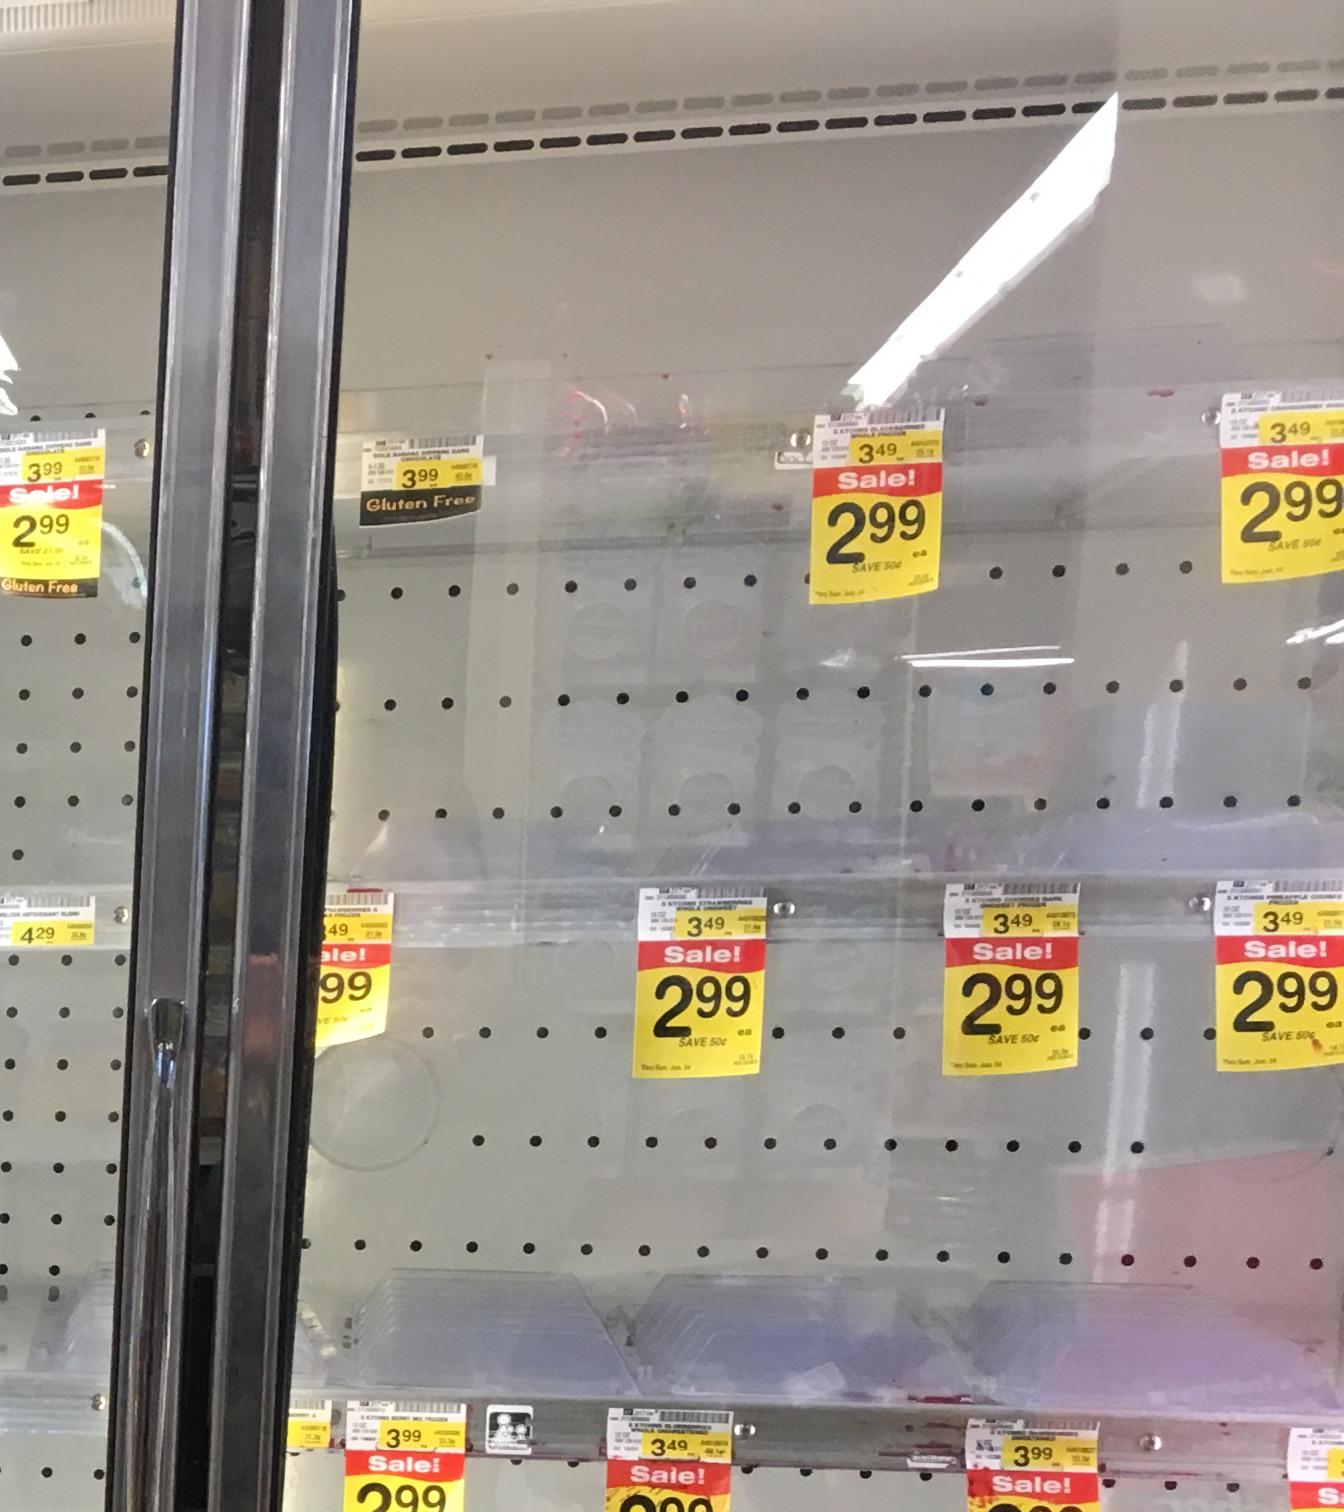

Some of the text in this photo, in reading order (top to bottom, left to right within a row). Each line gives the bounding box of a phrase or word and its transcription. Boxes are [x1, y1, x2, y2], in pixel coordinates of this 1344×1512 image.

[1270, 421, 1311, 443] 349
[858, 442, 897, 464] 349
[1247, 448, 1330, 470] Sale!
[27, 461, 62, 483] 399
[401, 467, 438, 489] 399
[837, 468, 916, 490] Sale!
[366, 493, 476, 512] Gluten Free
[1240, 478, 1344, 543] 299
[12, 514, 70, 548] 299
[825, 498, 926, 566] 299
[852, 561, 881, 573] SAVE
[1, 578, 79, 594] Gluten Free
[323, 923, 348, 941] 49
[687, 916, 725, 938] 349
[993, 913, 1032, 934] 349
[1262, 910, 1303, 933] 349
[20, 926, 55, 944] 429
[320, 947, 366, 962] ale!
[664, 945, 741, 963] Sale!
[972, 941, 1053, 961] Sale!
[1243, 938, 1328, 958] Sale!
[319, 970, 372, 1004] 99
[653, 974, 751, 1038] 299
[961, 971, 1063, 1036] 299
[1232, 969, 1338, 1032] 299
[678, 1037, 707, 1048] SAVE
[987, 1034, 1017, 1045] SAVE
[1261, 1031, 1293, 1042] SAVE
[385, 1428, 422, 1449] 399
[650, 1438, 688, 1457] 349
[368, 1455, 441, 1473] Sale!
[1013, 1446, 1053, 1467] 399
[630, 1465, 705, 1485] Sale!
[991, 1475, 1072, 1494] Sale!
